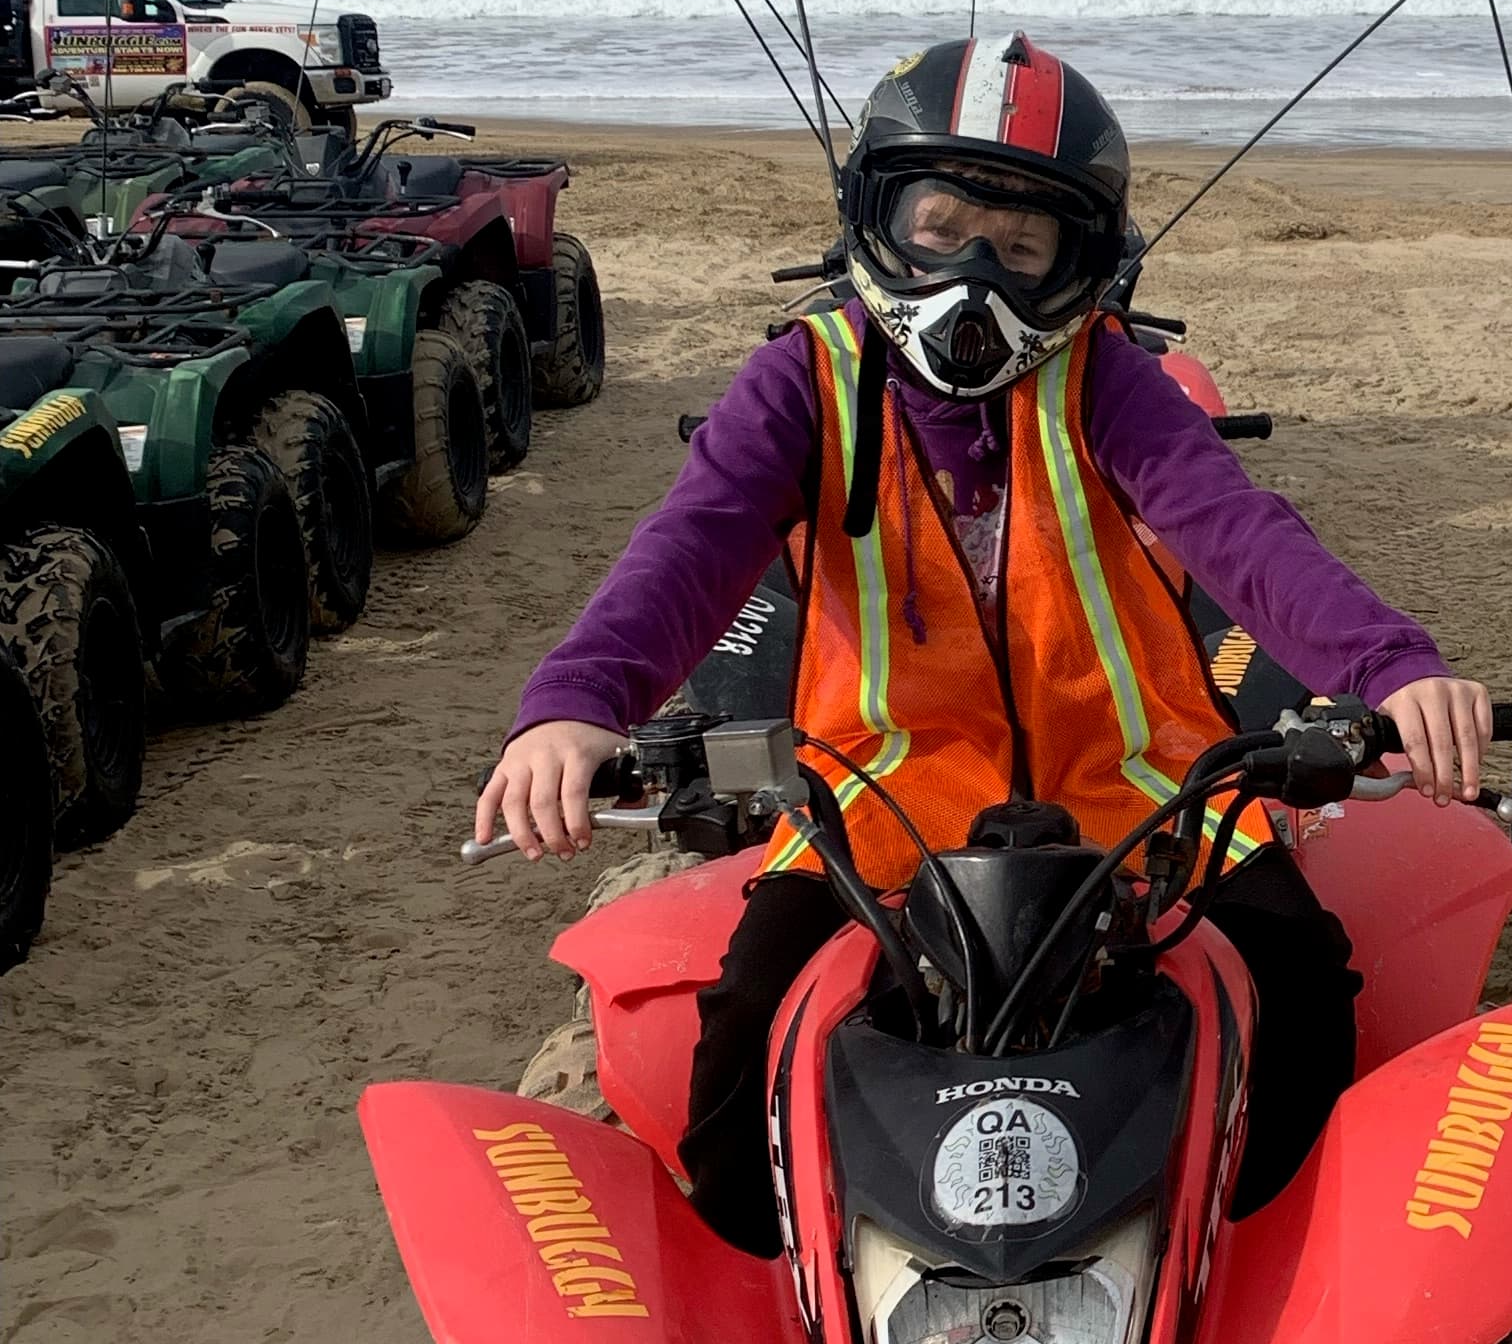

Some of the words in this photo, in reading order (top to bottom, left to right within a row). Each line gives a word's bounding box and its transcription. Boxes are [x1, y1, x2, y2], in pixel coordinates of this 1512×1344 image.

[935, 1076, 1081, 1105] HONDA
[976, 1109, 1033, 1135] QA
[973, 1182, 1036, 1215] 213
[472, 1122, 650, 1319] SUNBUGGY
